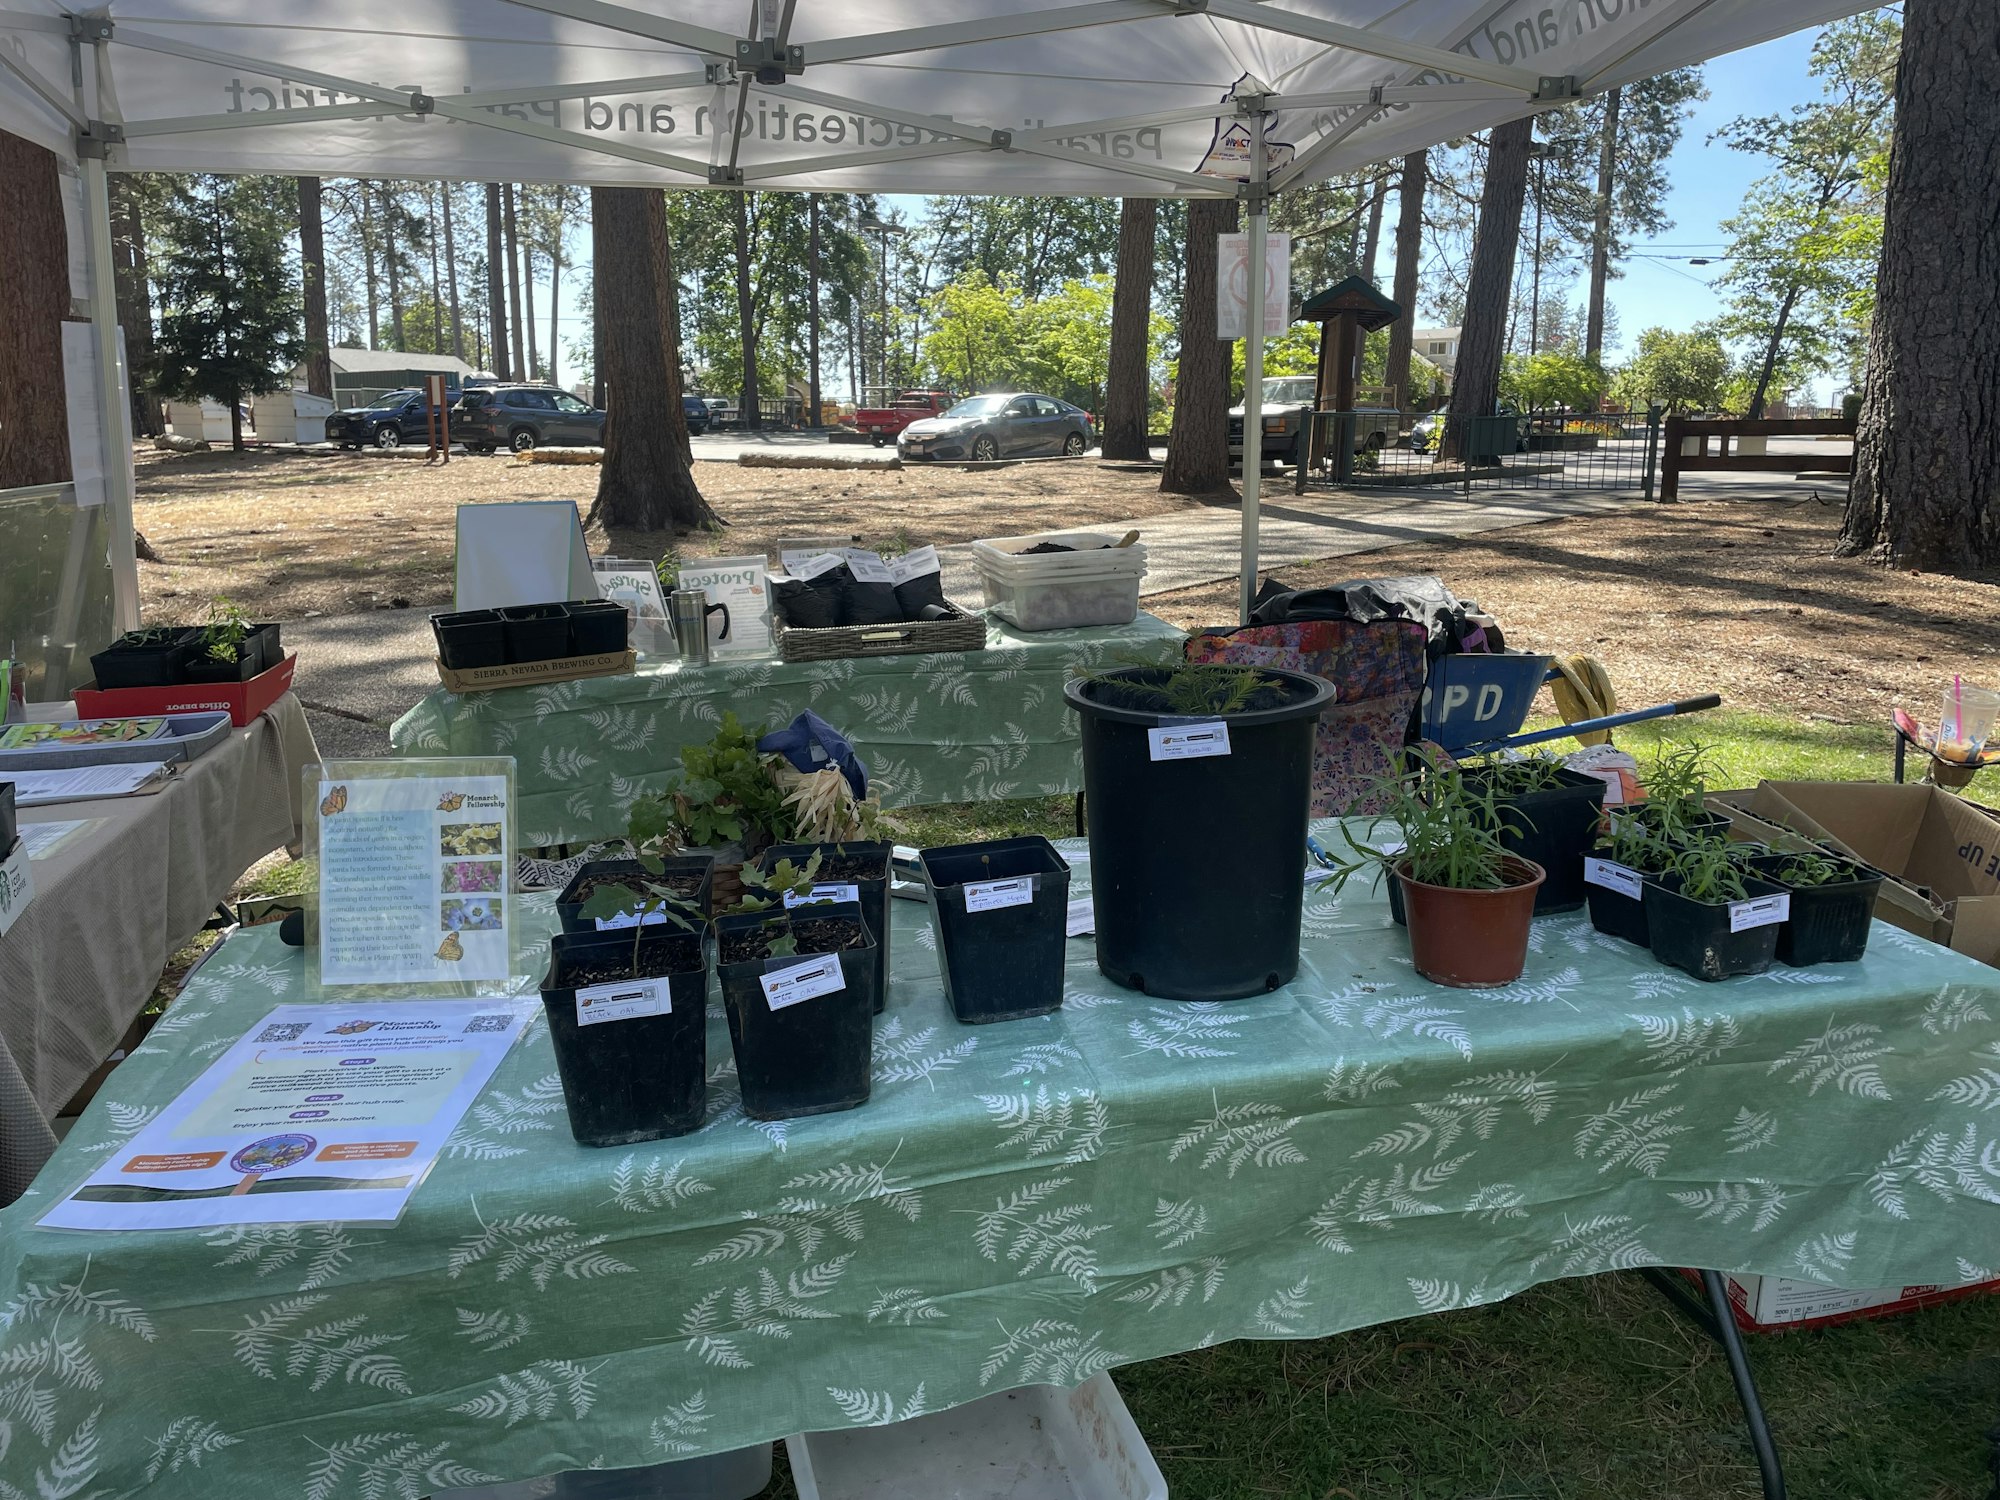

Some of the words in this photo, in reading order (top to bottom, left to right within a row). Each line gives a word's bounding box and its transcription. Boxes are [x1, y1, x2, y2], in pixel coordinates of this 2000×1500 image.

[511, 664, 549, 675] NEVADA
[551, 659, 595, 670] BREWING
[197, 701, 231, 711] Office
[1958, 841, 1984, 867] UP
[620, 1006, 637, 1014] OAK
